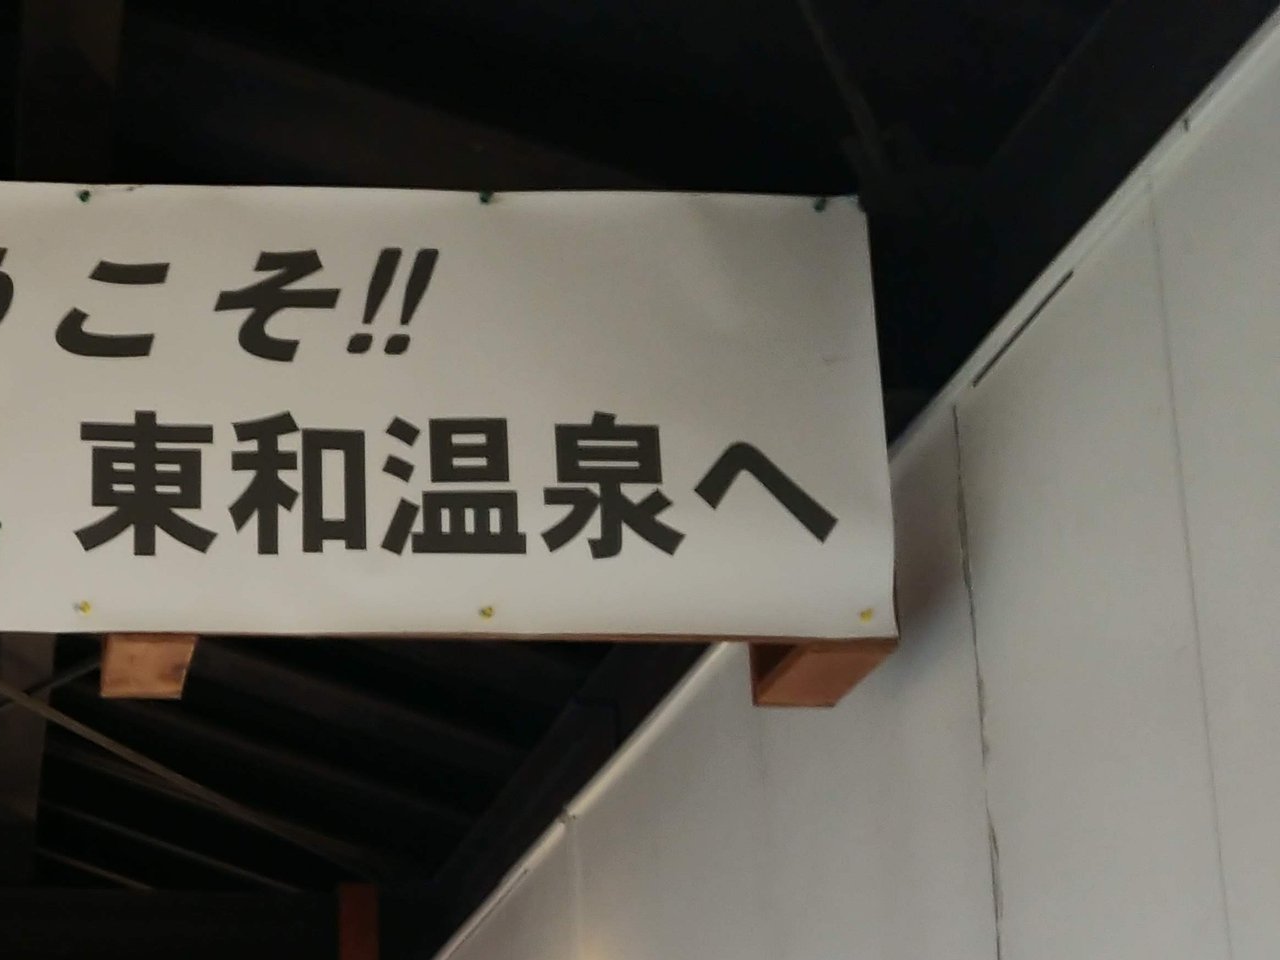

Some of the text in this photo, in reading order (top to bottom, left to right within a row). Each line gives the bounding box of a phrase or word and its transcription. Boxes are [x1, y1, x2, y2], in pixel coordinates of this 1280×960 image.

[74, 410, 838, 560] 東和温泉へ
